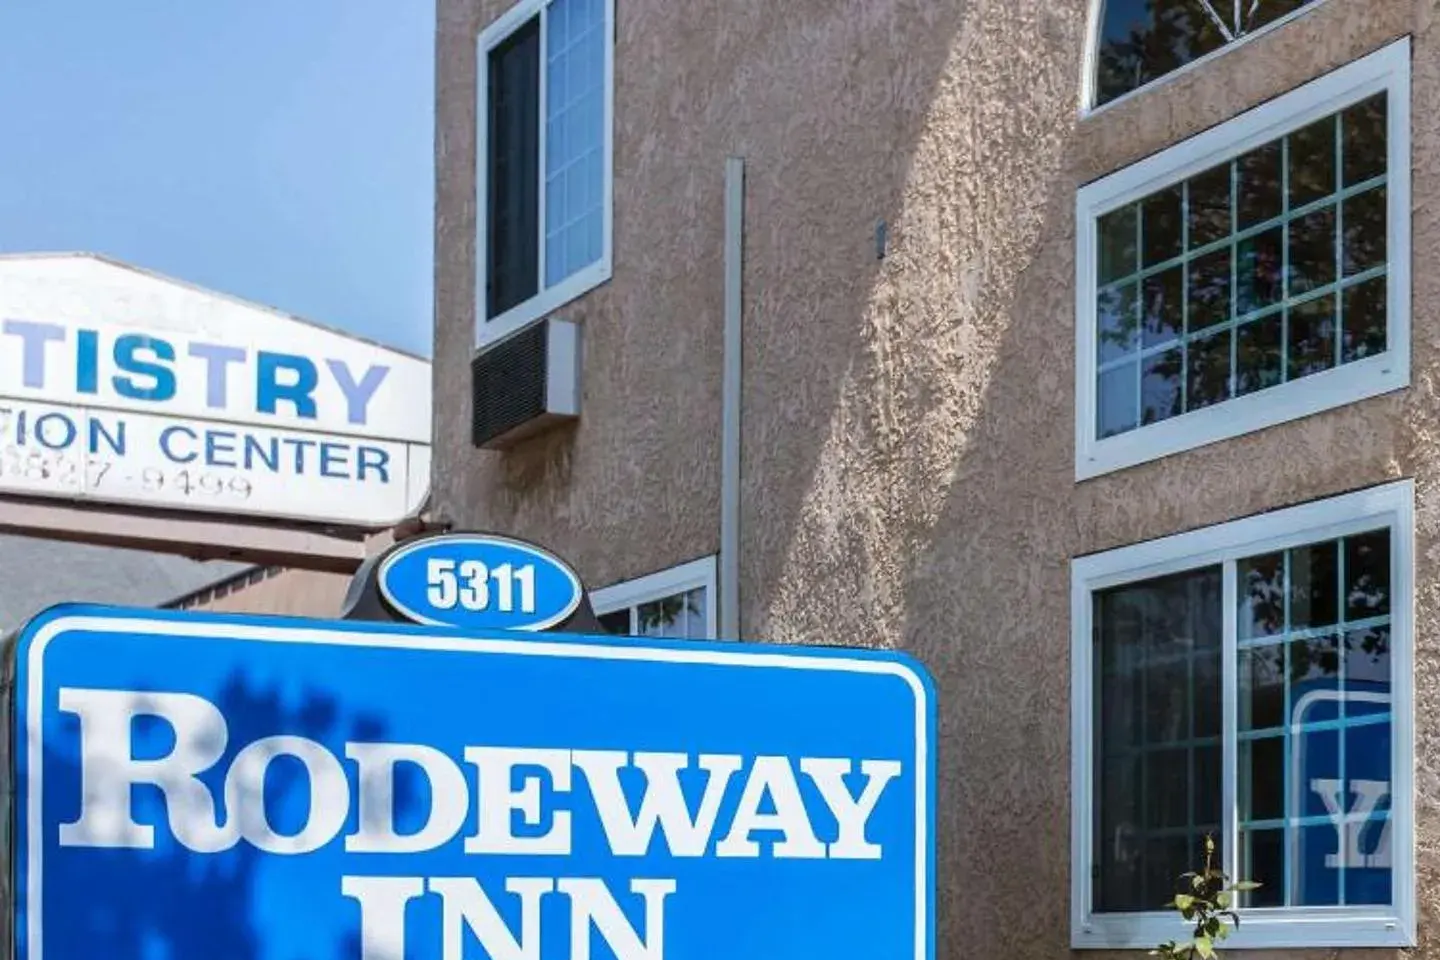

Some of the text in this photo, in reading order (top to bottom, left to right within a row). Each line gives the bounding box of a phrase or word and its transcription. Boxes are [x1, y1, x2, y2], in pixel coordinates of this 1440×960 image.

[3, 320, 390, 425] TISTRY
[160, 425, 390, 483] CENTER
[427, 558, 535, 614] 5311
[59, 687, 901, 860] RODEWAY
